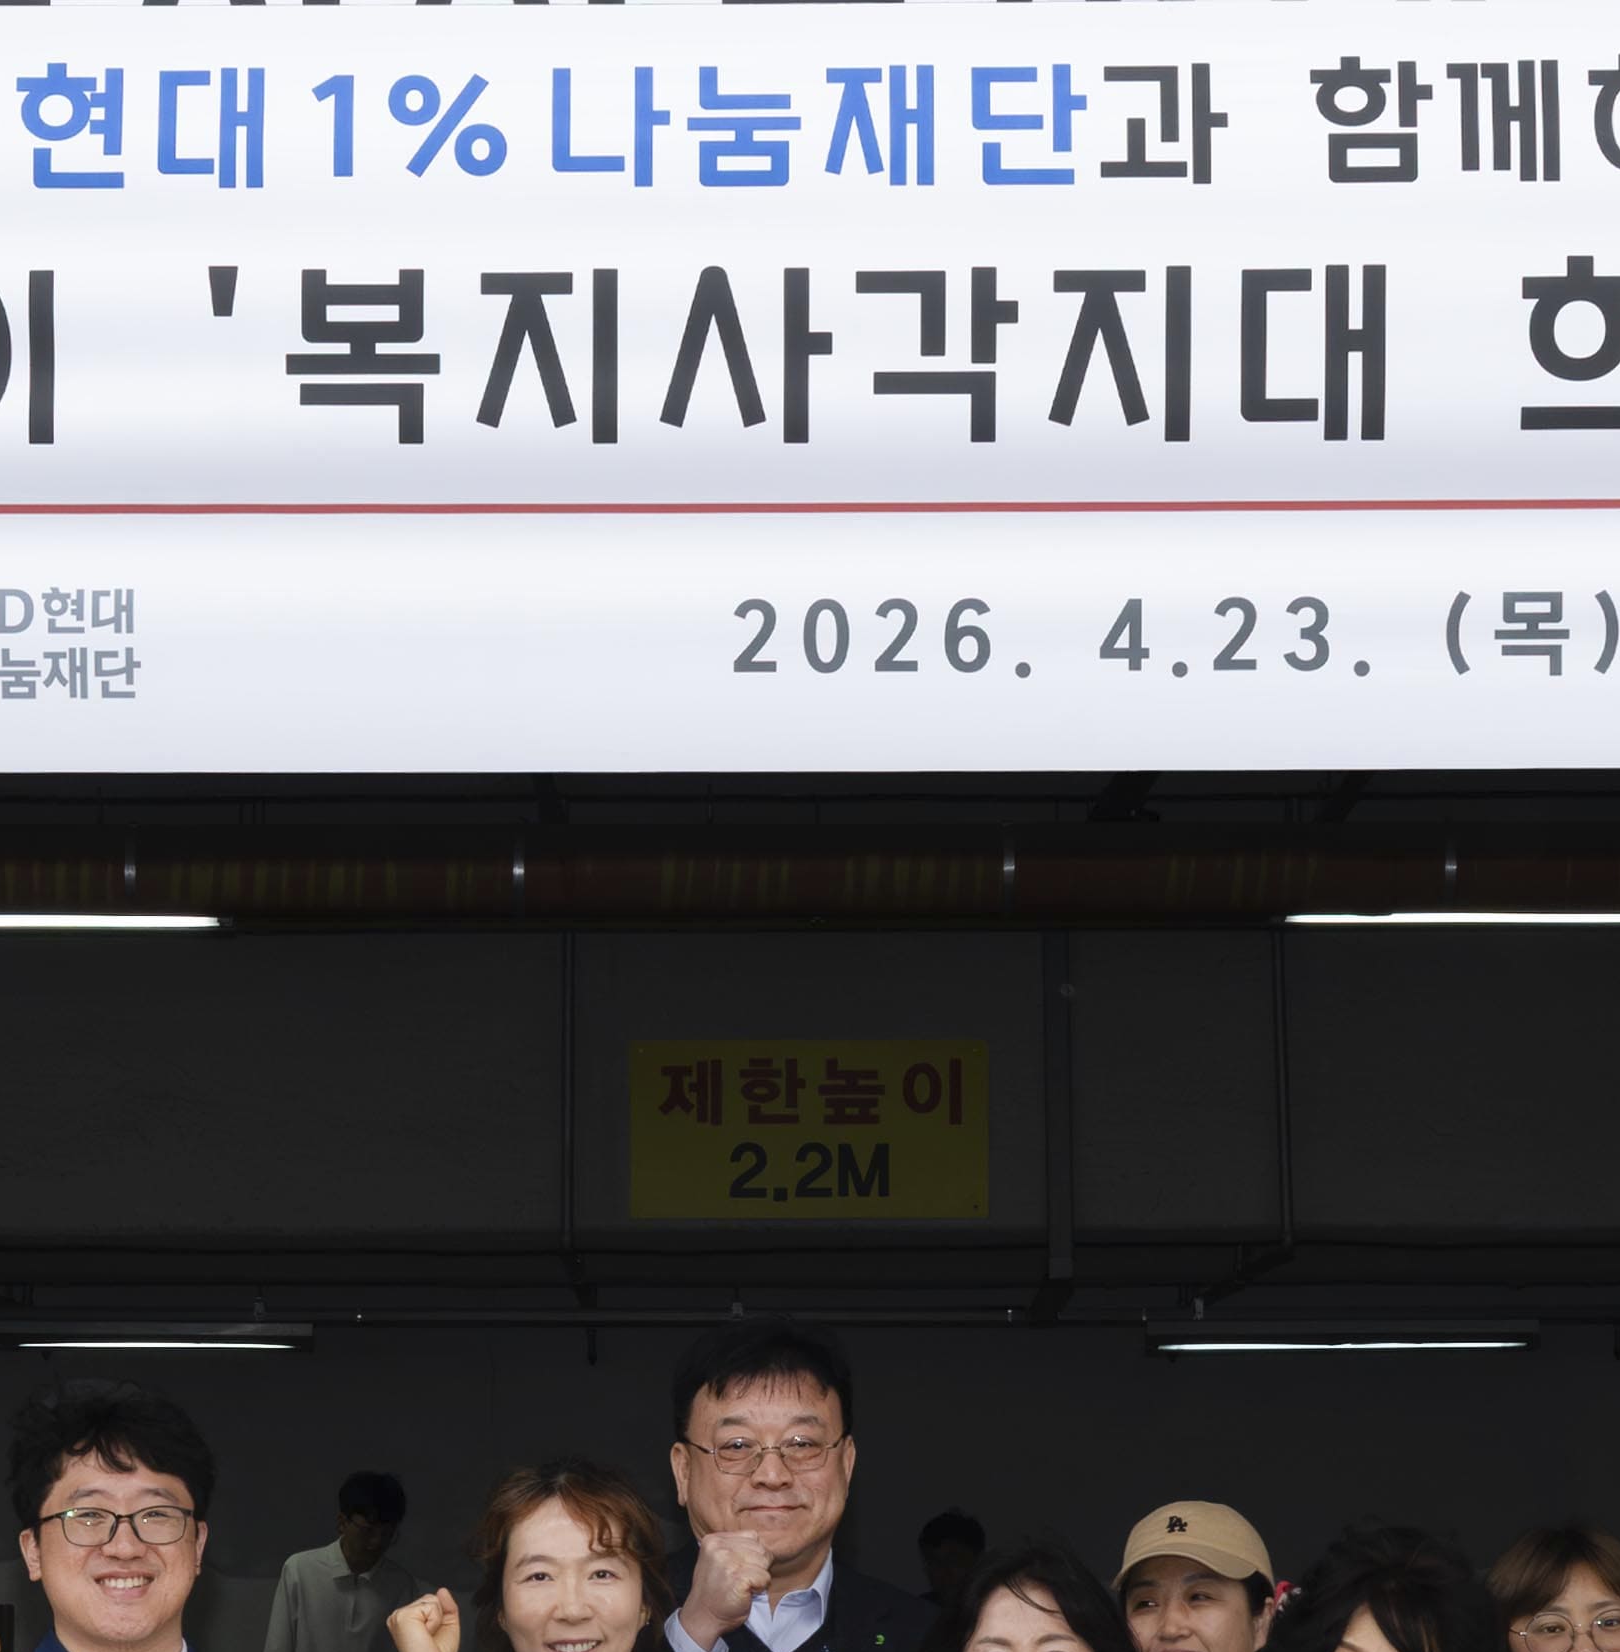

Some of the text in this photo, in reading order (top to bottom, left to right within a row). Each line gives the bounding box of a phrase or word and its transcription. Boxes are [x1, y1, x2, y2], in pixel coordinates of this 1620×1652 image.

[208, 263, 1387, 445] '복지사각지대
[733, 589, 1620, 679] 2026. 4.23. (목)
[657, 1057, 963, 1126] 제한높이
[728, 1142, 891, 1202] 2.2M
